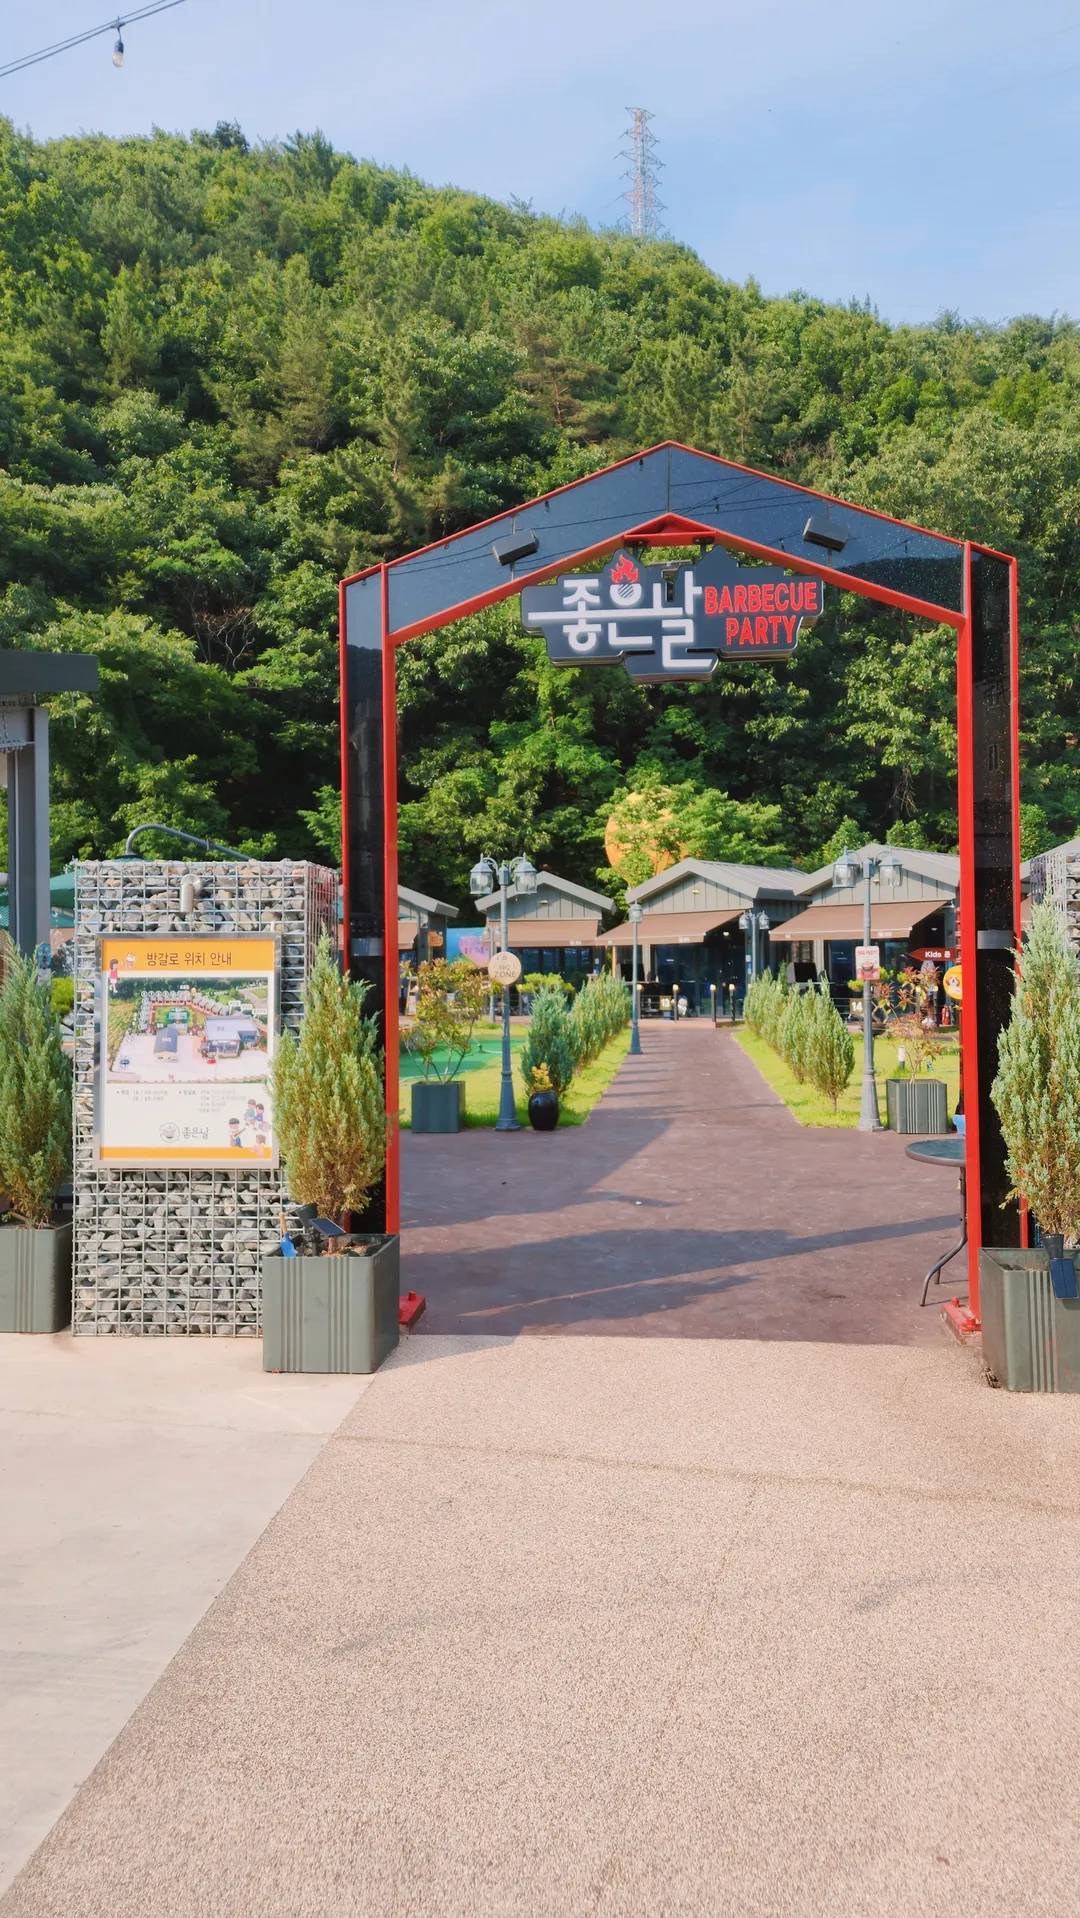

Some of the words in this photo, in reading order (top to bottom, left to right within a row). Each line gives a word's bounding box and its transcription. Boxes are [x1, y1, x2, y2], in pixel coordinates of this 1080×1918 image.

[704, 582, 818, 615] BARBECUE
[726, 615, 797, 646] PARTY
[146, 952, 180, 966] 방갈로
[184, 952, 206, 966] 위치
[210, 952, 232, 966] 안내
[851, 1001, 863, 1011] 14
